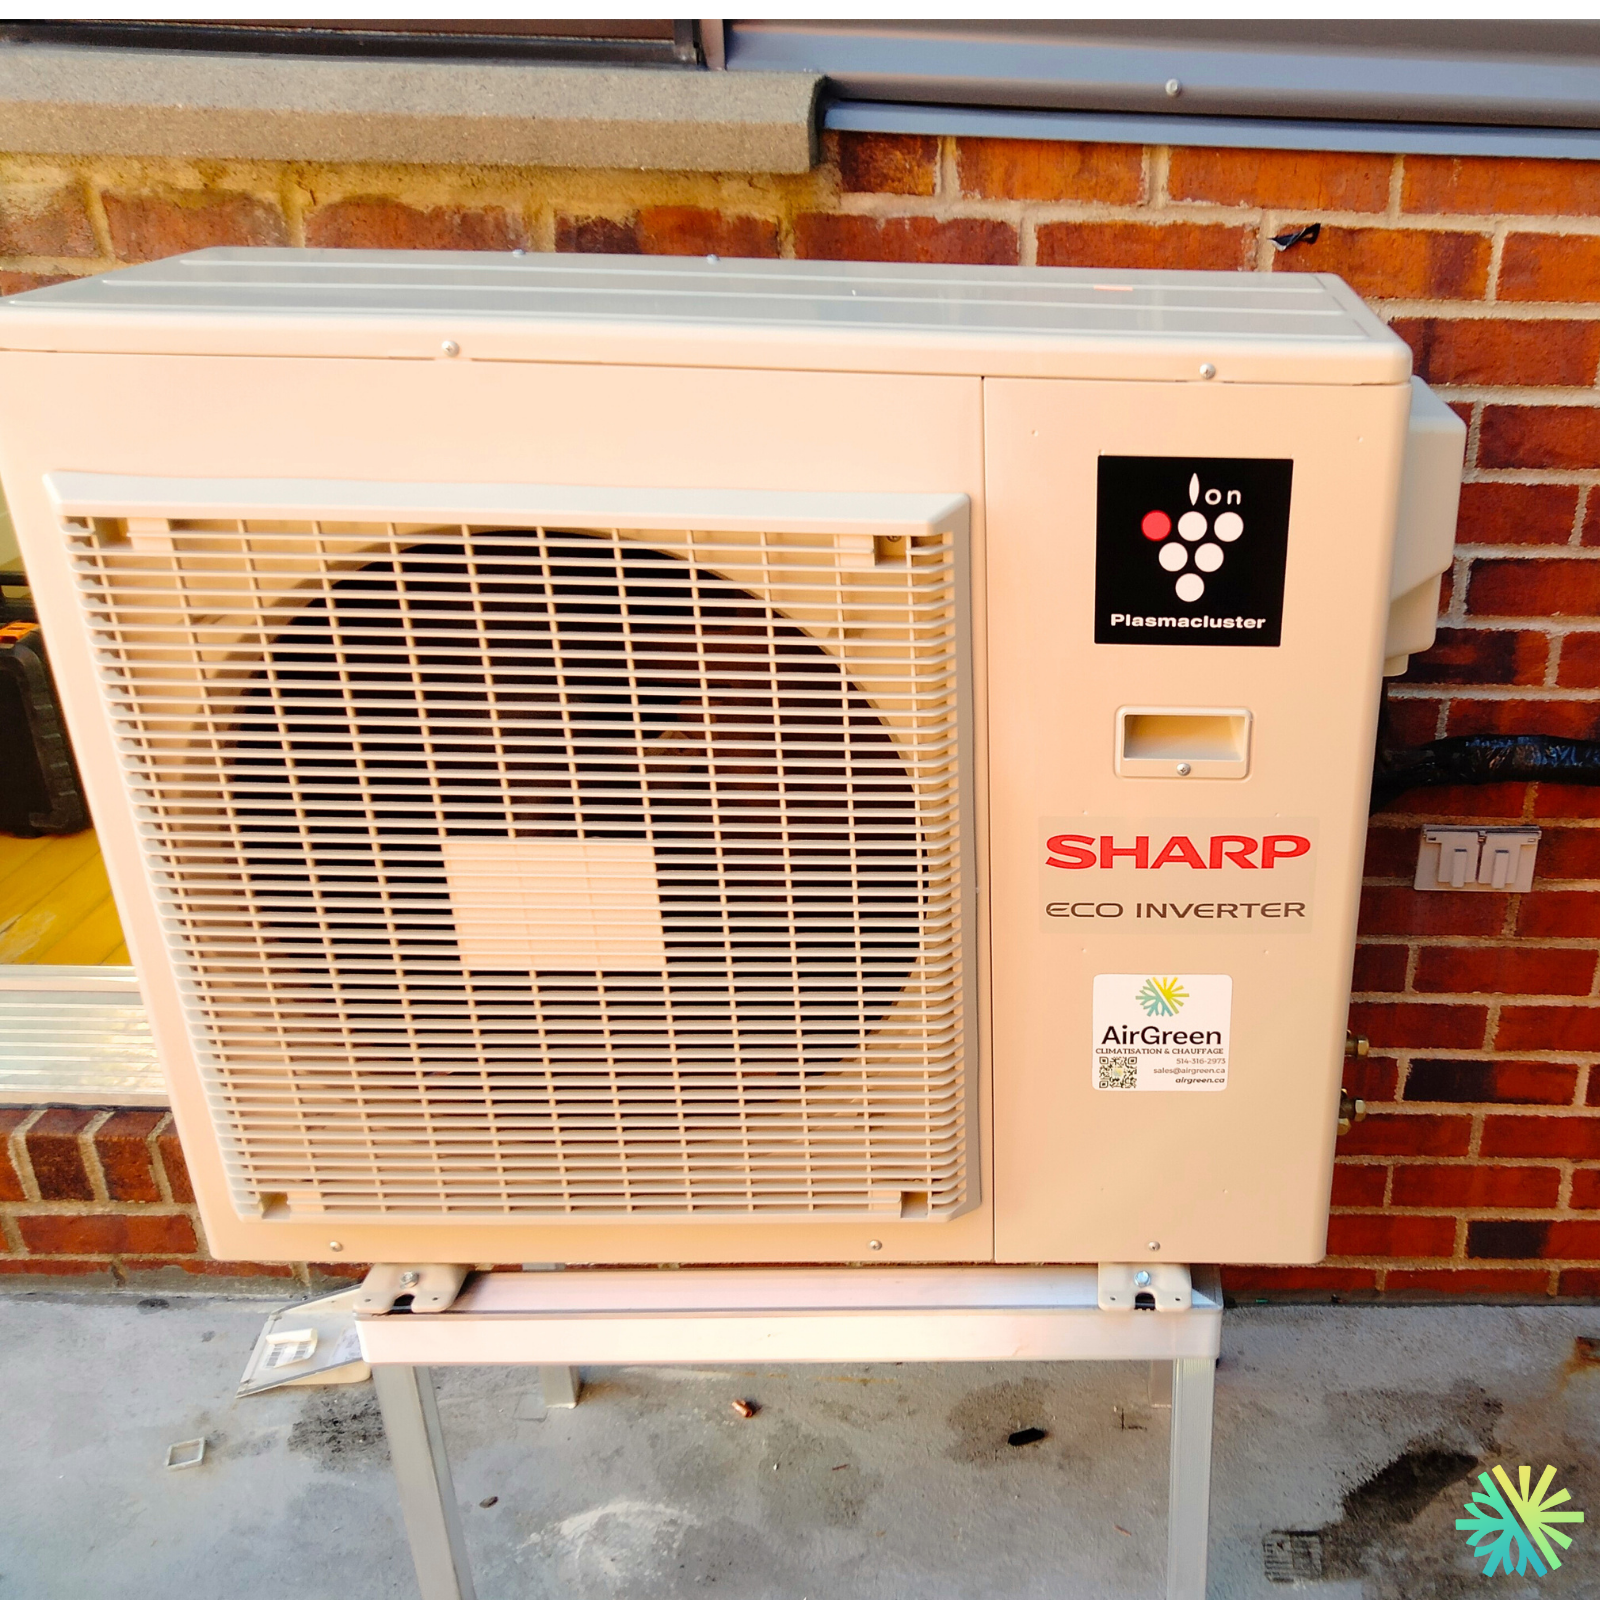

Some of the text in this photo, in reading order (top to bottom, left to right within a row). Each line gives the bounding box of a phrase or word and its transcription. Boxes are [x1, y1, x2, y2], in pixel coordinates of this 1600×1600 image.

[1110, 613, 1266, 629] Plasmacluster
[1045, 834, 1311, 870] SHARP
[1045, 902, 1306, 919] ECO INVERTER
[1101, 1024, 1222, 1045] AirGreen
[1153, 1067, 1226, 1075] sales@airgreen.ca
[1175, 1077, 1225, 1085] airgreen.ca
